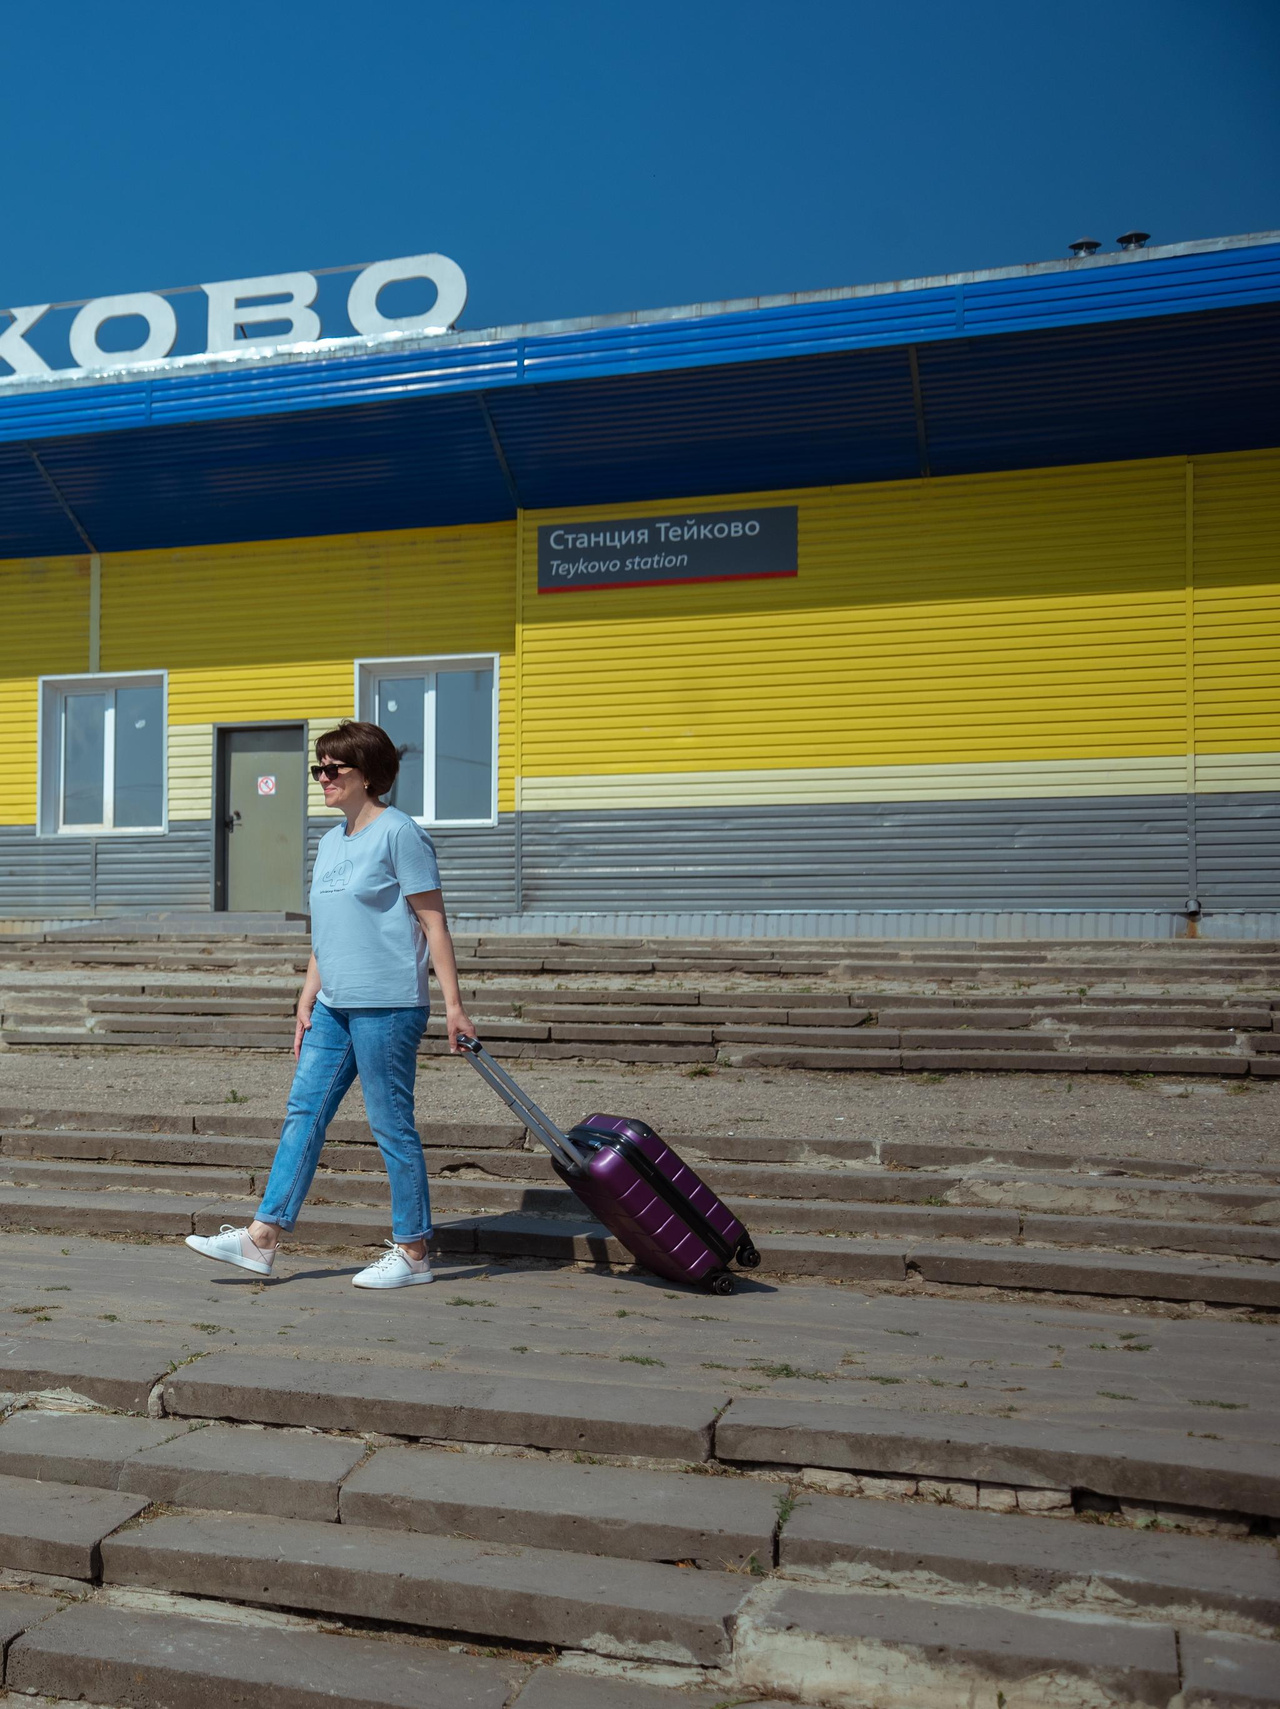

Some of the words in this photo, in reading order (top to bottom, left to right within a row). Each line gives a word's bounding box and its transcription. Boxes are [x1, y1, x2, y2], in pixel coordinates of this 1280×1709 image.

[549, 528, 649, 550] Станция
[656, 518, 760, 542] Тейково
[550, 557, 620, 579] Teykovo
[624, 552, 688, 571] station
